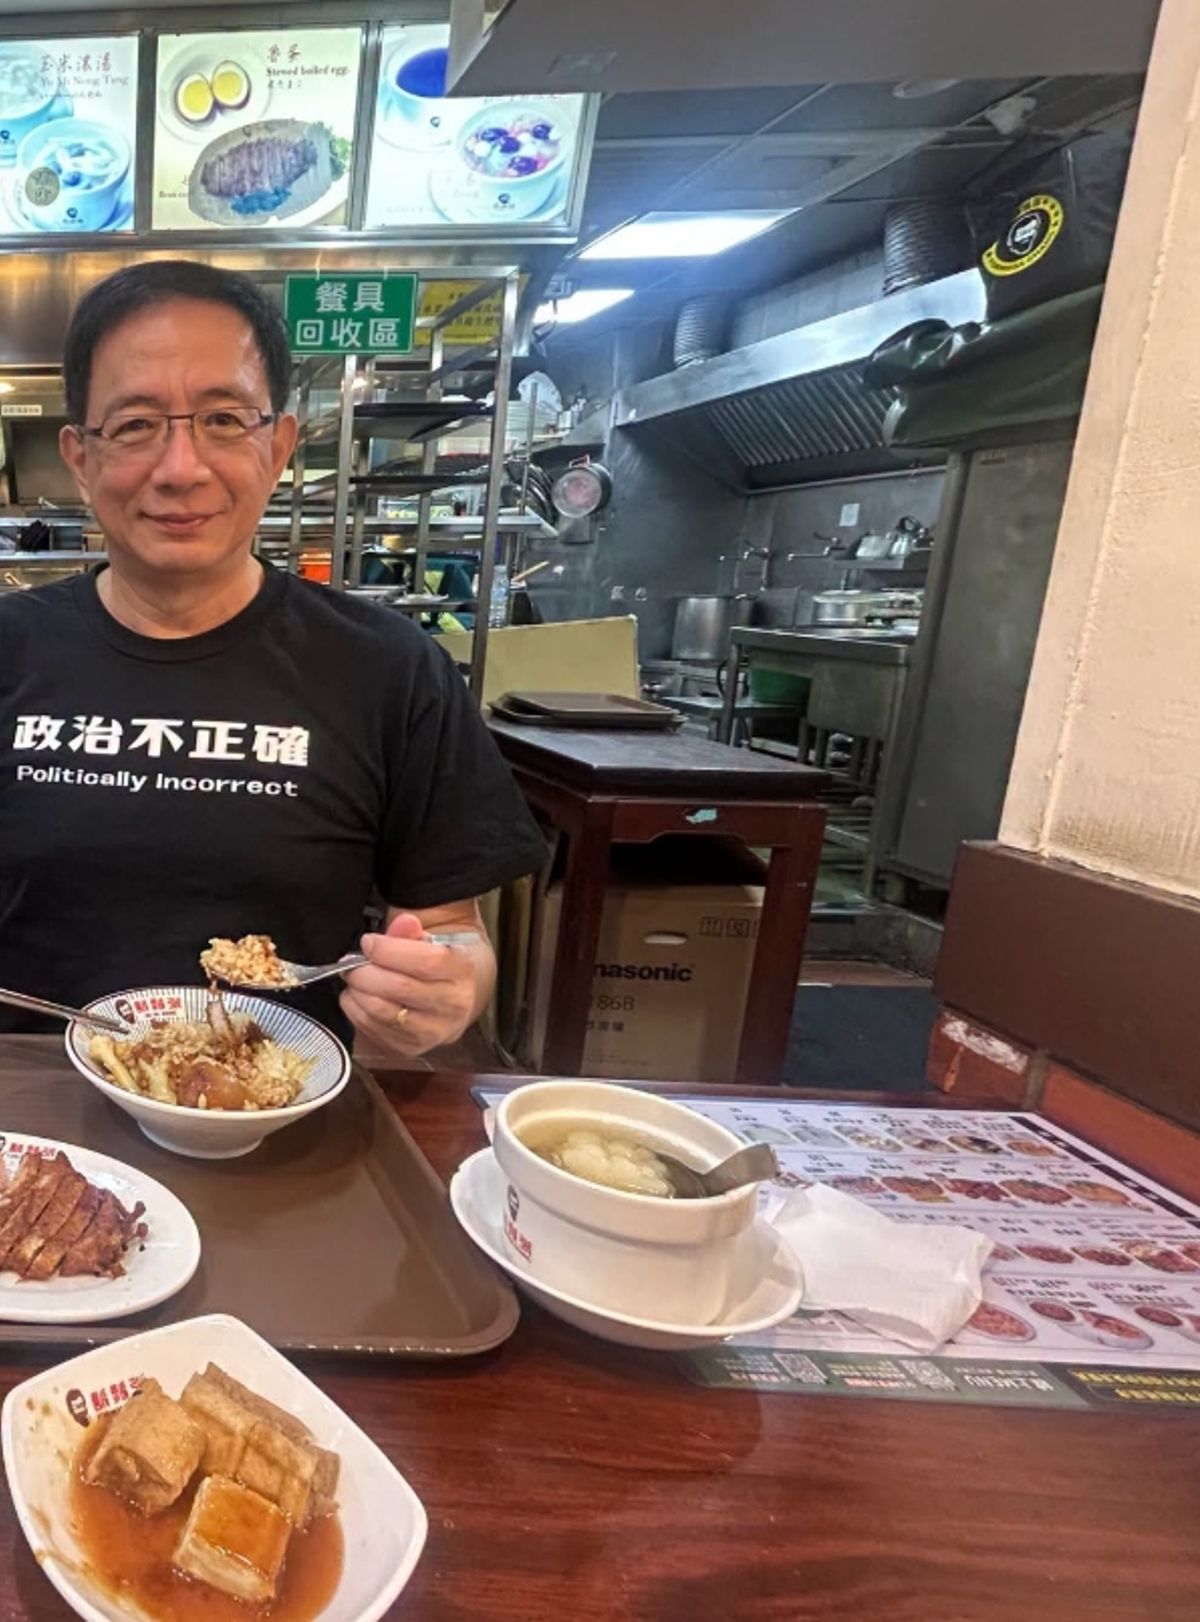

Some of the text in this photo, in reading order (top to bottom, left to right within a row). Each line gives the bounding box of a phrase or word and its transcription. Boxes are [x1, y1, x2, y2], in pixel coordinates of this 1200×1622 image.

[316, 281, 385, 312] 餐具
[296, 317, 401, 348] 回收區
[12, 714, 310, 767] 政治不正確
[17, 765, 299, 797] Politically Incorrect
[593, 963, 693, 982] nasonic
